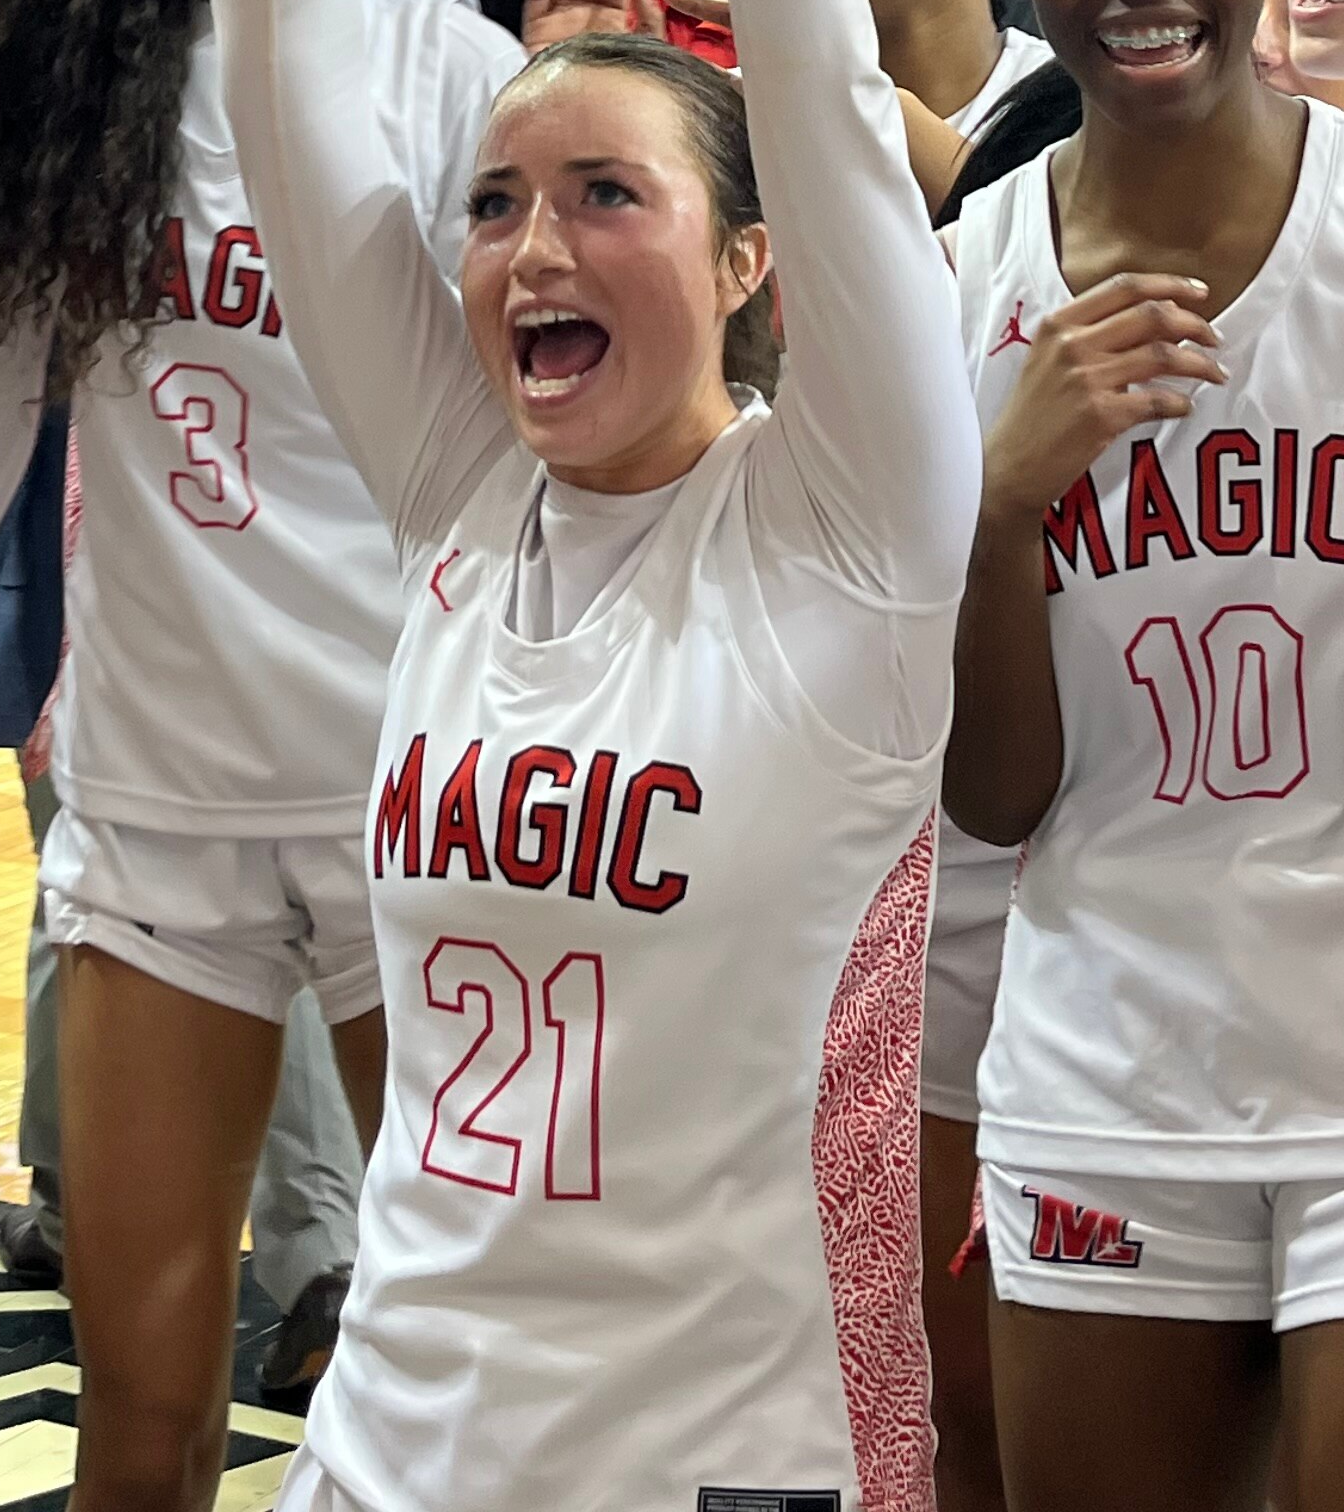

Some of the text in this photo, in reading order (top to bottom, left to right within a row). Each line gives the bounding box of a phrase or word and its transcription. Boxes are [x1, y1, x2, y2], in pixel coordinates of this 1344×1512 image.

[150, 362, 258, 532] 3
[1124, 603, 1310, 805] 10
[374, 732, 702, 915] MAGIC
[422, 935, 605, 1201] 21
